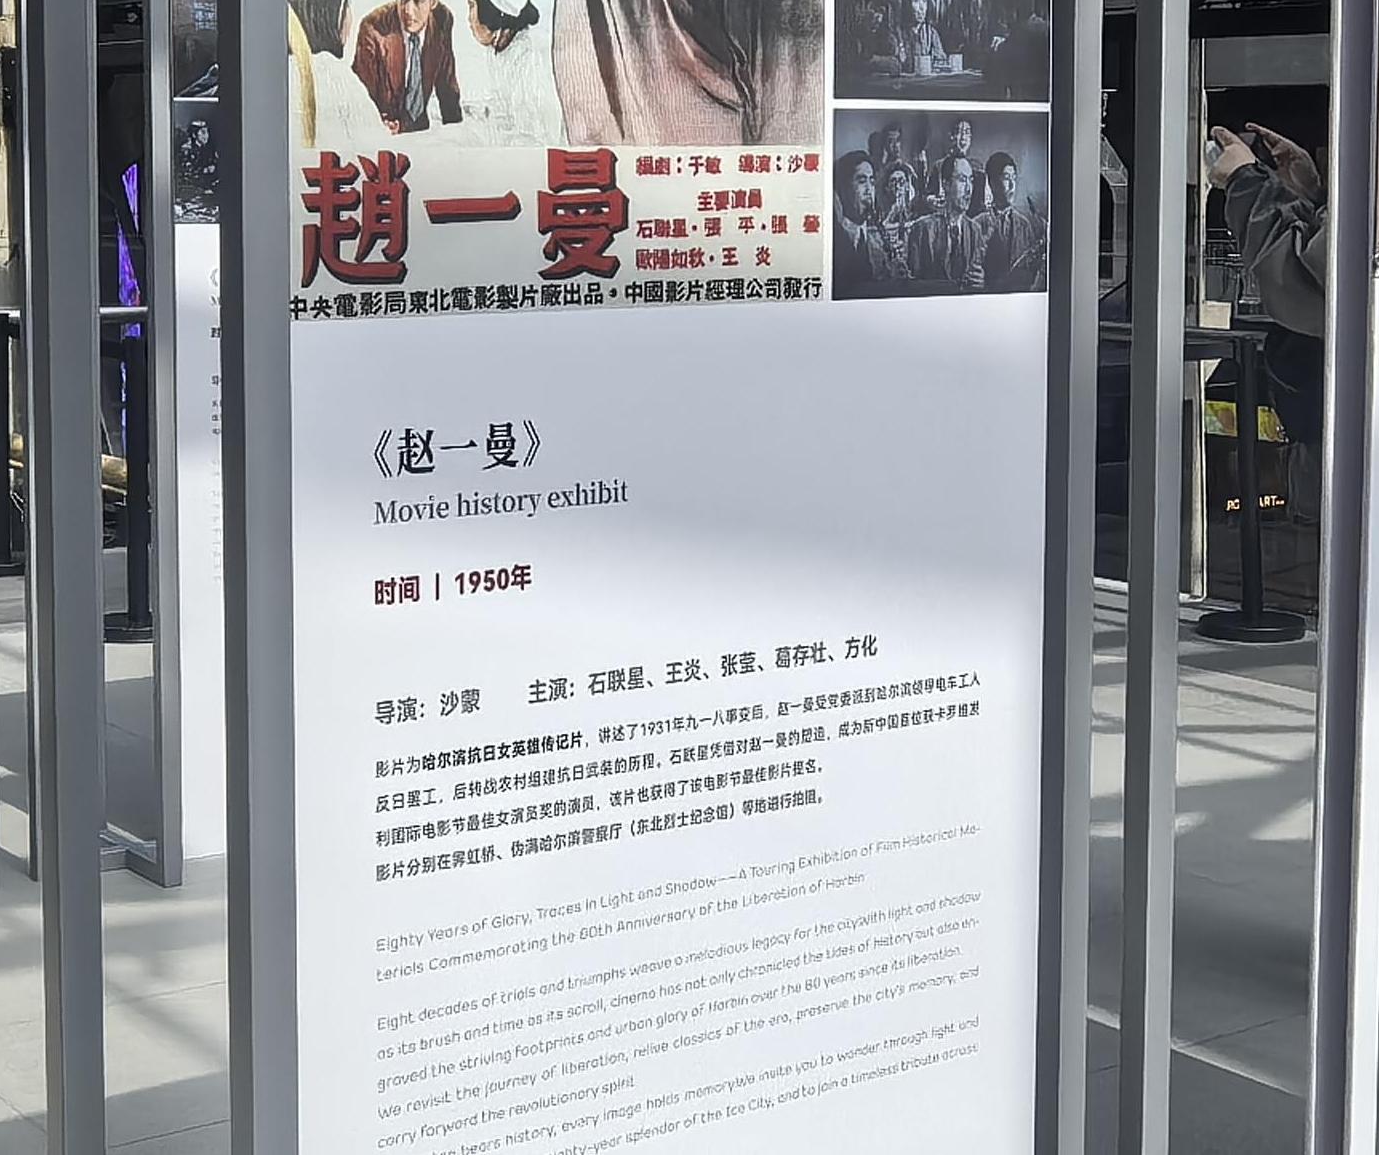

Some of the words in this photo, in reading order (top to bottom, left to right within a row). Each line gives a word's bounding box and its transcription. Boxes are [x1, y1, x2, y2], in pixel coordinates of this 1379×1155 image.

[301, 148, 631, 289] 趙一曼
[373, 419, 542, 479] 《赵一曼》
[373, 496, 451, 526] Movie
[456, 487, 541, 519] history
[547, 478, 629, 510] exhibit
[374, 575, 421, 606] 时间
[454, 564, 532, 597] 1950年
[375, 688, 480, 725] 导演：沙蒙
[376, 933, 423, 953] Eighty
[427, 924, 468, 942] Years
[471, 917, 489, 934] of
[491, 912, 532, 929] Glory,
[536, 902, 581, 920] Traces
[585, 898, 596, 912] in
[600, 891, 633, 910] Light
[751, 861, 795, 879] Touring
[798, 848, 857, 870] Exhibition
[860, 842, 872, 857] of
[903, 827, 956, 848] Historical
[376, 961, 423, 982] terials
[429, 937, 547, 971] Commemorating
[552, 931, 574, 947] the
[616, 907, 694, 933] Anniversary
[699, 901, 712, 916] of
[716, 898, 738, 913] the
[742, 884, 805, 908] Liberation
[809, 878, 821, 894] of
[377, 1011, 414, 1032] Eight
[418, 999, 477, 1022] decades
[482, 991, 496, 1008] of
[500, 986, 535, 1005] trials
[568, 967, 625, 990] triumphs
[630, 958, 670, 977] weave
[752, 933, 791, 952] legacy
[794, 927, 811, 941] for
[814, 923, 834, 938] the
[888, 905, 911, 923] light
[939, 892, 980, 910] shadow
[377, 1046, 393, 1060] as
[398, 1040, 415, 1056] its
[420, 1031, 459, 1051] brush
[492, 1018, 522, 1034] time
[527, 1014, 541, 1027] as
[547, 1010, 562, 1022] its
[567, 997, 605, 1019] scroll,
[610, 988, 655, 1008] cinema
[659, 982, 681, 998] has
[685, 974, 706, 992] not
[709, 969, 734, 987] only
[738, 954, 799, 980] chronicled
[803, 951, 822, 966] the
[826, 944, 855, 960] tides
[858, 938, 870, 953] of
[937, 920, 957, 935] also
[377, 1065, 426, 1094] graved
[431, 1062, 455, 1079] the
[459, 1049, 511, 1072] striving
[515, 1032, 583, 1059] footprints
[615, 1017, 652, 1036] urban
[656, 1010, 687, 1030] glory
[691, 1002, 704, 1022] of
[751, 987, 776, 1004] over
[780, 983, 801, 998] the
[805, 976, 820, 992] 80
[858, 963, 887, 979] since
[890, 957, 905, 973] its
[377, 1104, 400, 1120] We
[406, 1090, 451, 1113] revisit
[456, 1086, 479, 1101] the
[483, 1073, 536, 1099] journey
[541, 1064, 556, 1082] of
[562, 1052, 628, 1076] liberation,
[633, 1041, 668, 1059] relive
[673, 1028, 721, 1050] classics
[726, 1021, 740, 1037] of
[744, 1018, 764, 1033] the
[796, 998, 848, 1024] preserve
[853, 993, 871, 1007] the
[875, 984, 904, 1002] city's
[377, 1130, 416, 1149] carry
[420, 1113, 477, 1139] forward
[481, 1109, 504, 1124] the
[509, 1085, 598, 1118] revolutionary
[505, 1124, 556, 1147] history,
[562, 1114, 598, 1133] every
[603, 1102, 641, 1122] image
[646, 1093, 678, 1111] holds
[758, 1065, 791, 1082] invite
[795, 1059, 817, 1076] you
[837, 1042, 881, 1062] wander
[883, 1029, 927, 1050] through
[931, 1022, 954, 1040] light
[625, 1120, 679, 1145] splendor
[700, 1109, 722, 1125] the
[726, 1104, 744, 1118] Ice
[748, 1096, 774, 1111] City,
[817, 1077, 838, 1097] join
[851, 1062, 898, 1084] timeless
[901, 1053, 938, 1072] tribute
[942, 1042, 978, 1061] across
